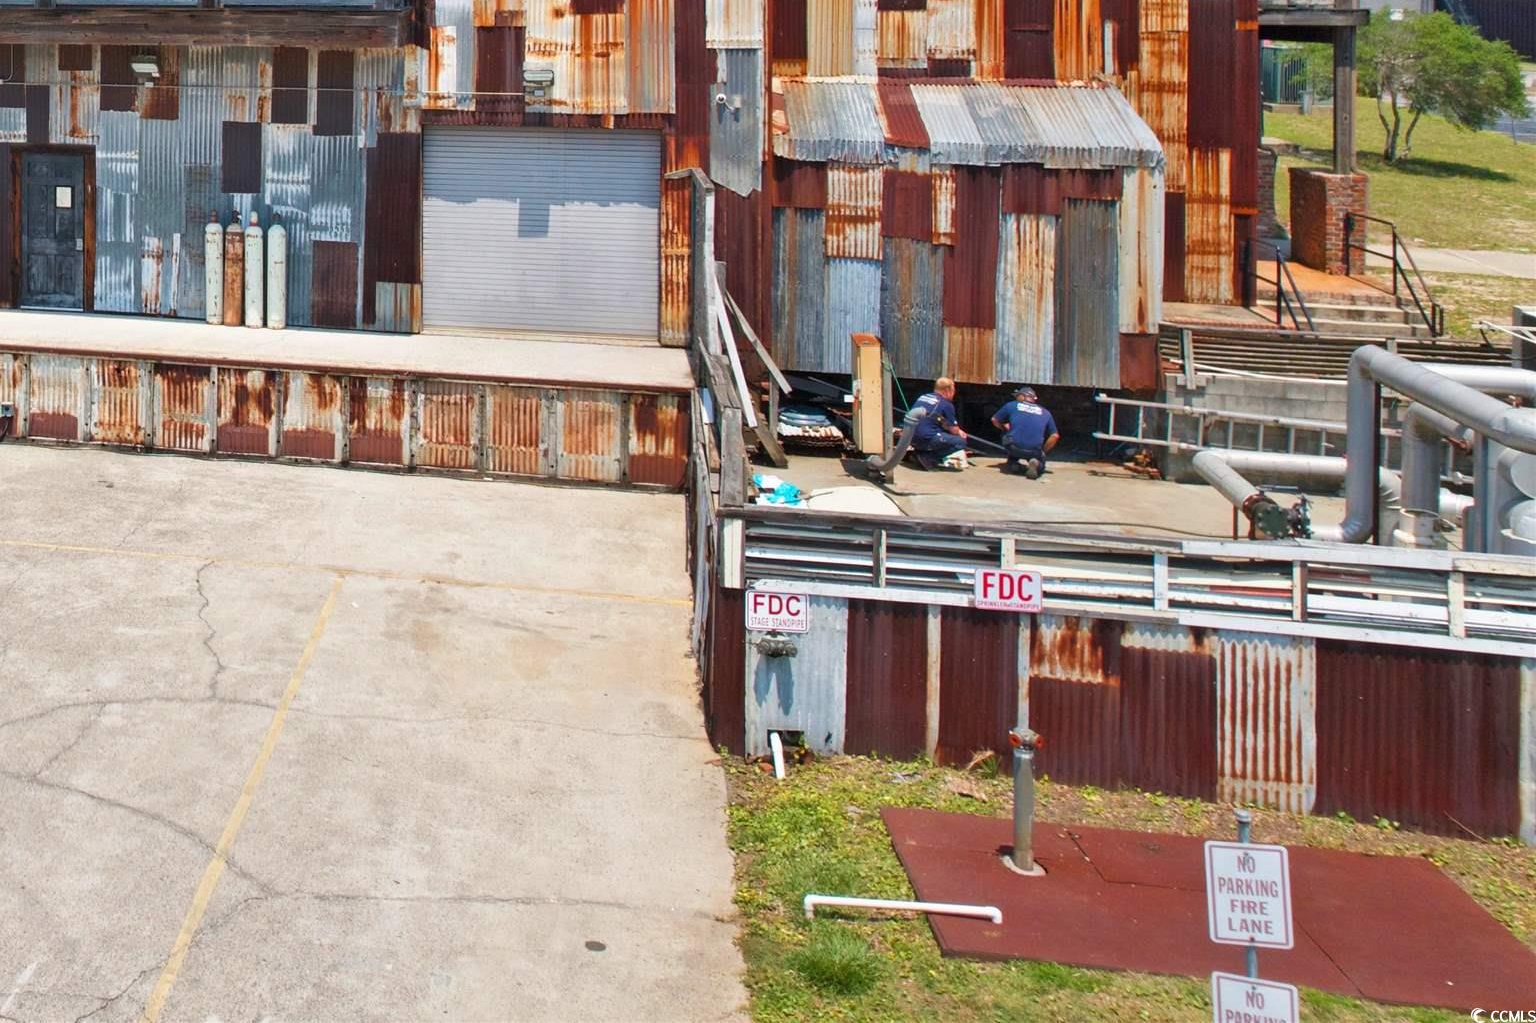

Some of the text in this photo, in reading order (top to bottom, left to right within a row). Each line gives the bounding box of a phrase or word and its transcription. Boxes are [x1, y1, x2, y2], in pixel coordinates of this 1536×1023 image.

[982, 572, 1033, 602] FDC
[753, 593, 801, 617] FDC
[750, 617, 769, 626] STAGE
[1237, 855, 1256, 874] NO
[1218, 876, 1279, 898] PARKING
[1230, 899, 1269, 915] FIRE
[1228, 917, 1274, 935] LANE
[1246, 990, 1265, 1010] NO
